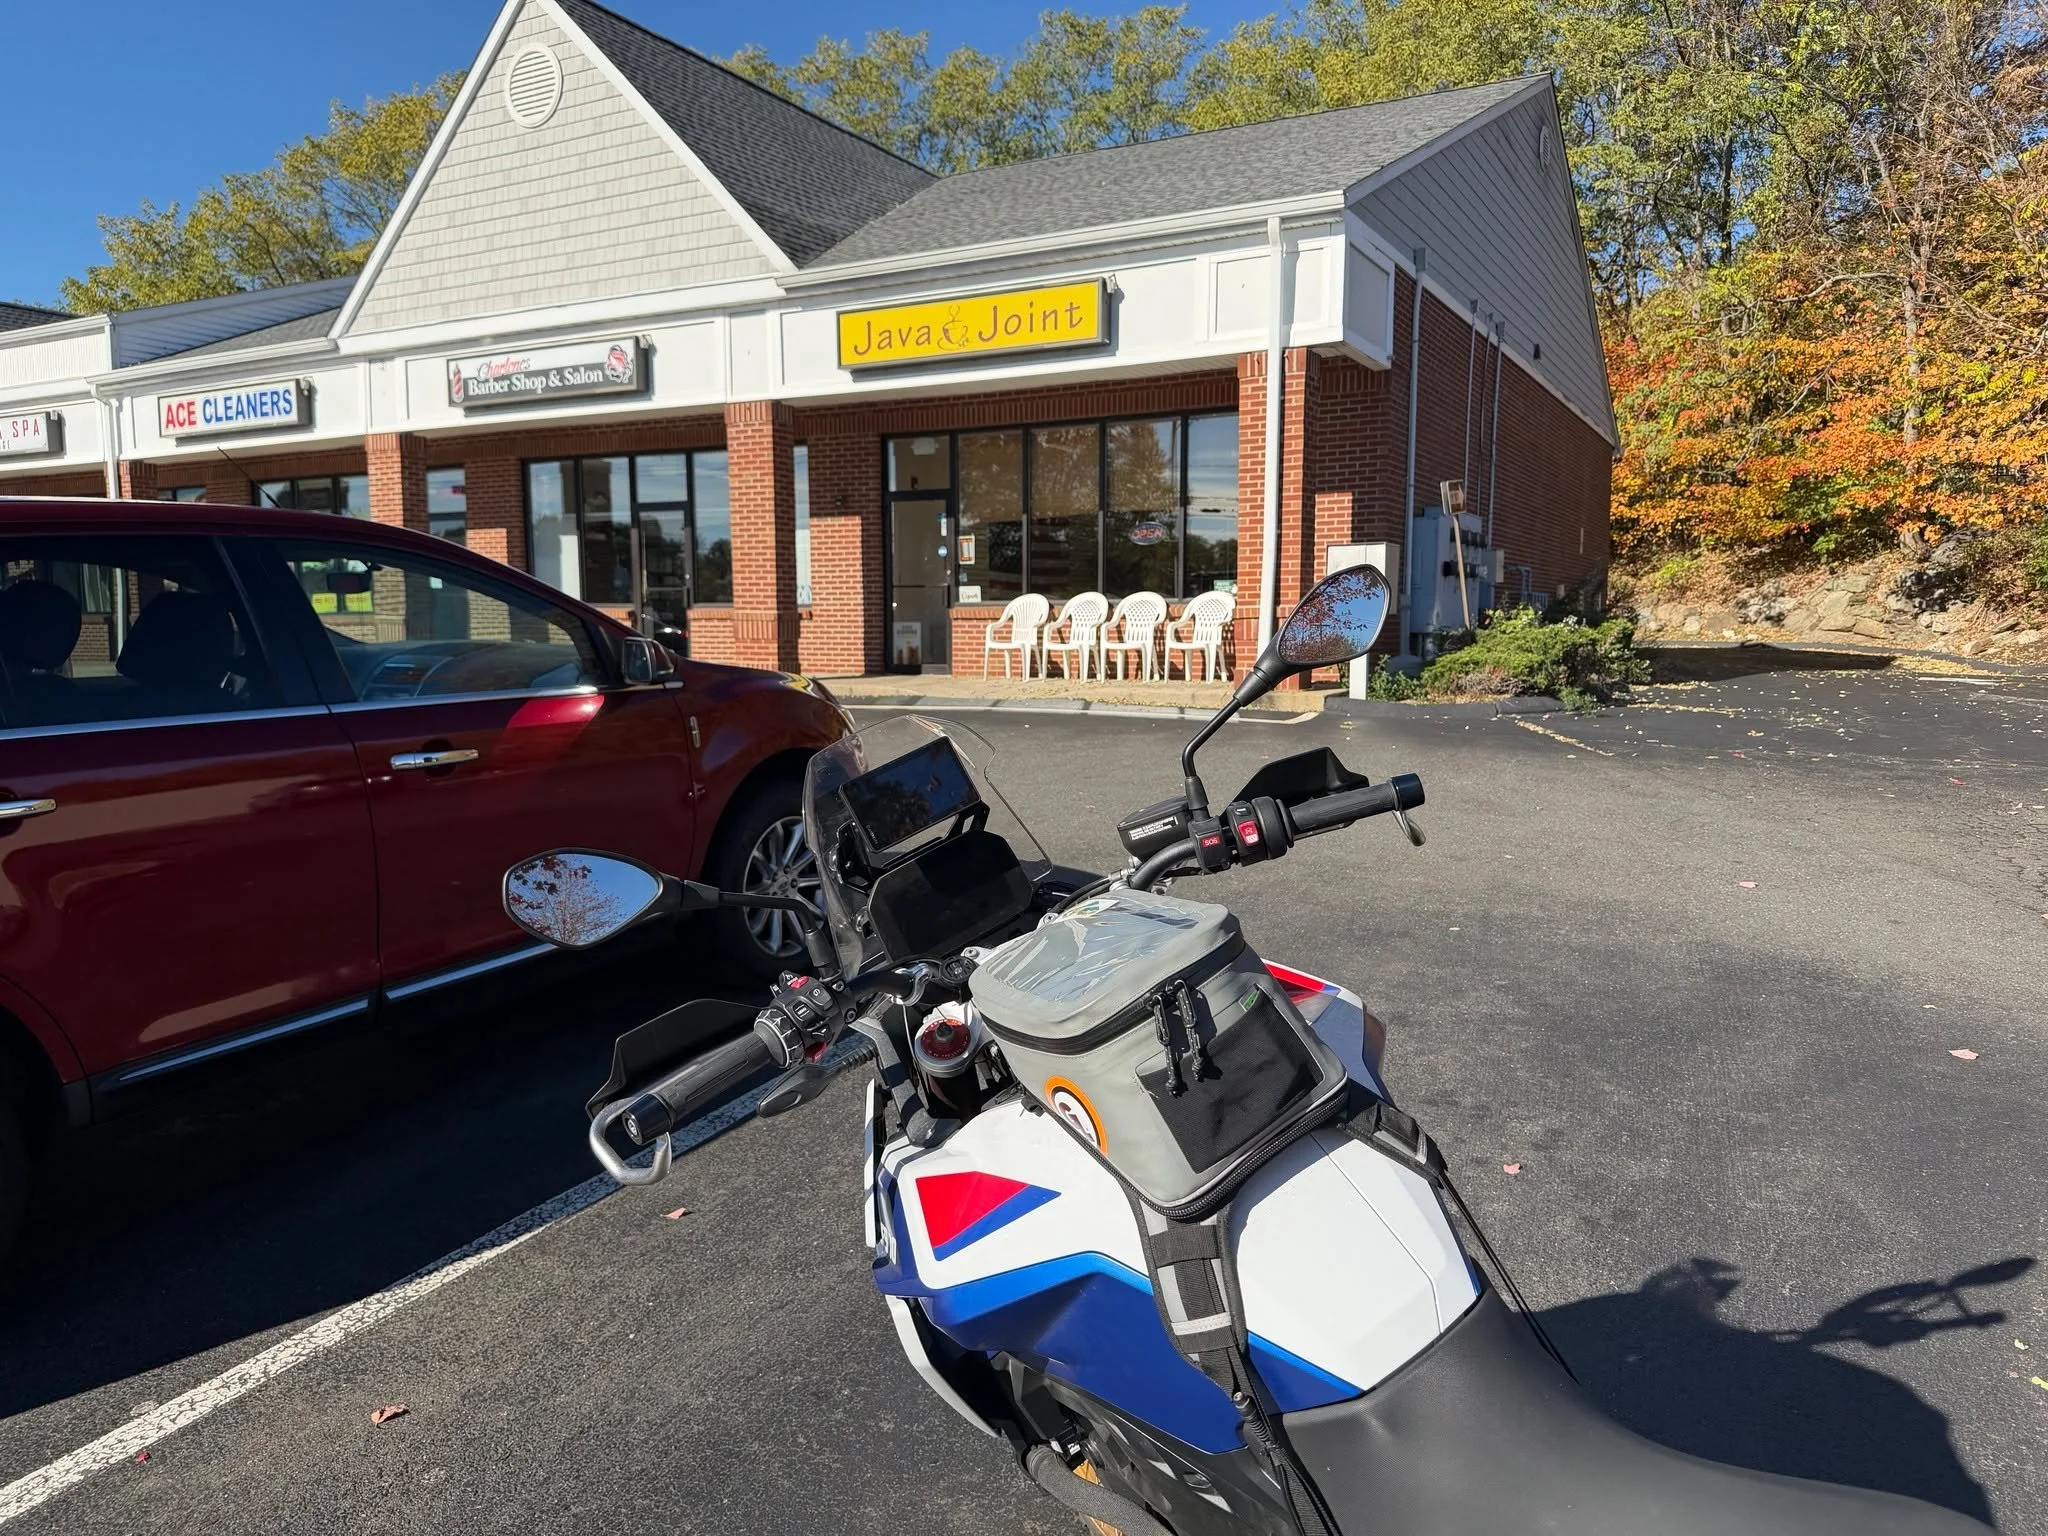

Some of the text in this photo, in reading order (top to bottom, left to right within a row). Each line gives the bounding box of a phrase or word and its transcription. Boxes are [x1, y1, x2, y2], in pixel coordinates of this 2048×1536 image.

[853, 301, 1083, 356] Java Joint
[468, 367, 604, 396] Barber Shop & Salon
[165, 388, 293, 429] ACE CLEANERS
[12, 418, 40, 438] SPA
[1132, 527, 1161, 540] OPEN
[1204, 837, 1218, 846] SOS
